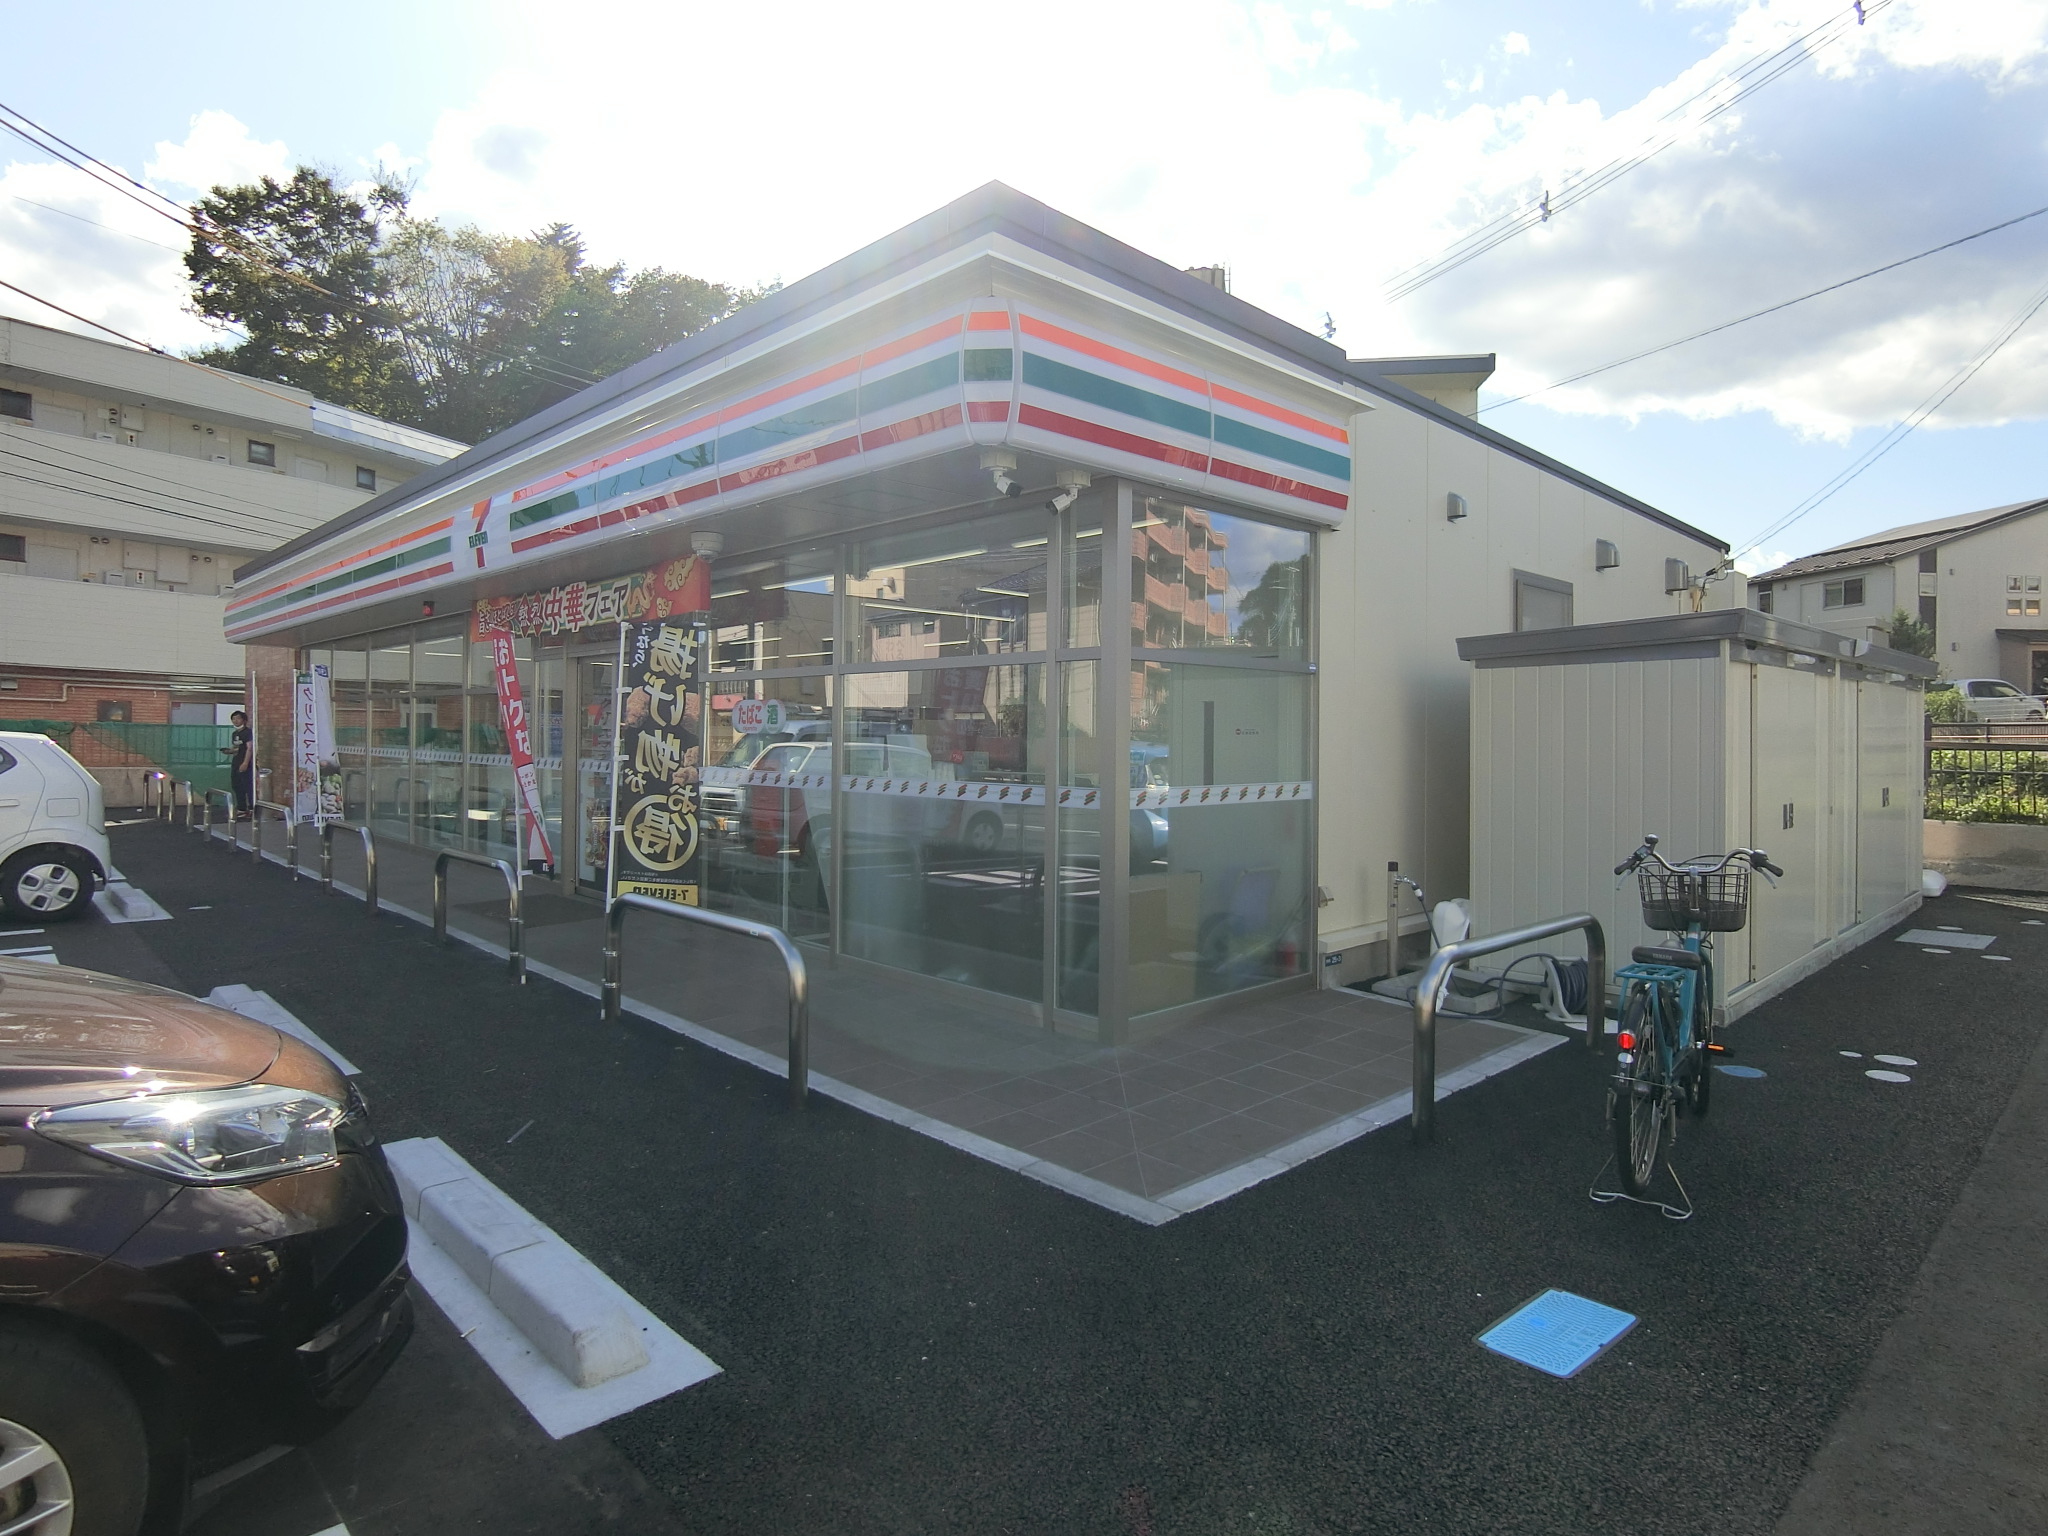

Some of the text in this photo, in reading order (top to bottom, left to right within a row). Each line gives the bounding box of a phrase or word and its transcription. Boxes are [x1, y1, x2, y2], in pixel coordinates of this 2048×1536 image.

[472, 496, 492, 568] 7
[738, 704, 763, 725] たばこ
[767, 704, 779, 725] 酒
